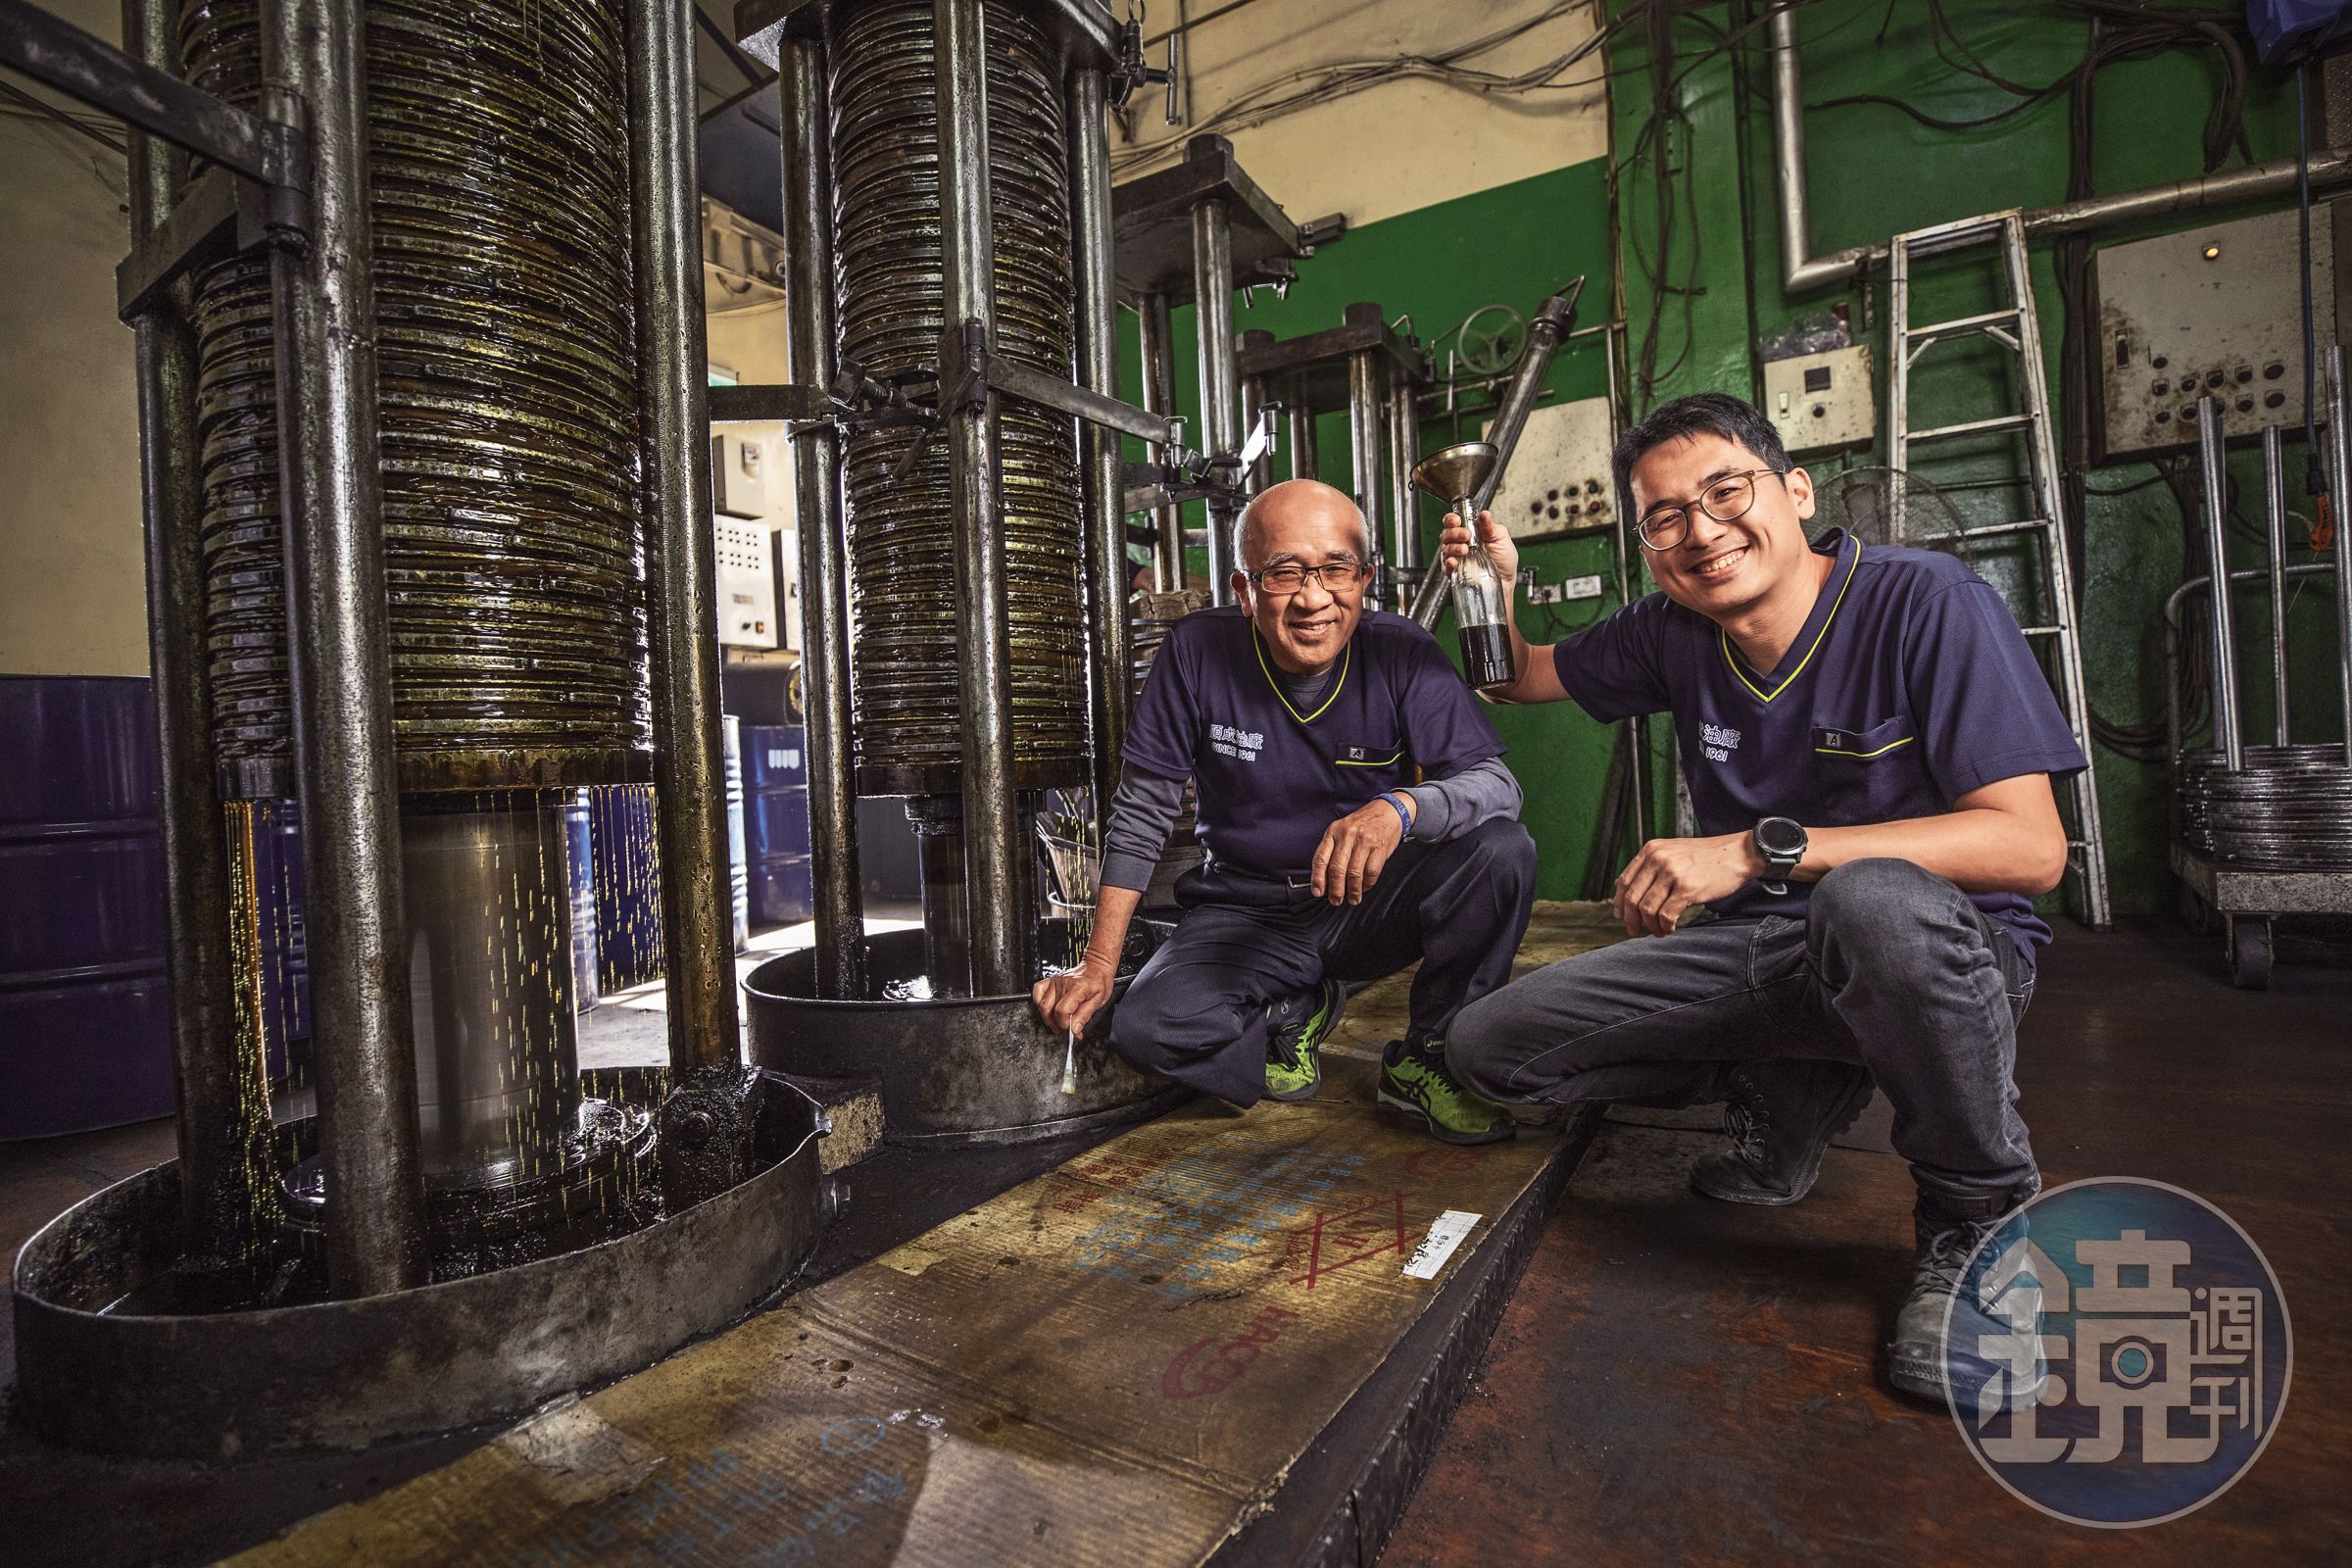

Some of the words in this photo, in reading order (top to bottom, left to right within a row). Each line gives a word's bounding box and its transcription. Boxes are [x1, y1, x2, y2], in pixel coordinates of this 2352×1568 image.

[1699, 721, 1740, 749] 油廠
[1237, 749, 1256, 761] 1961
[1705, 747, 1728, 761] 1961
